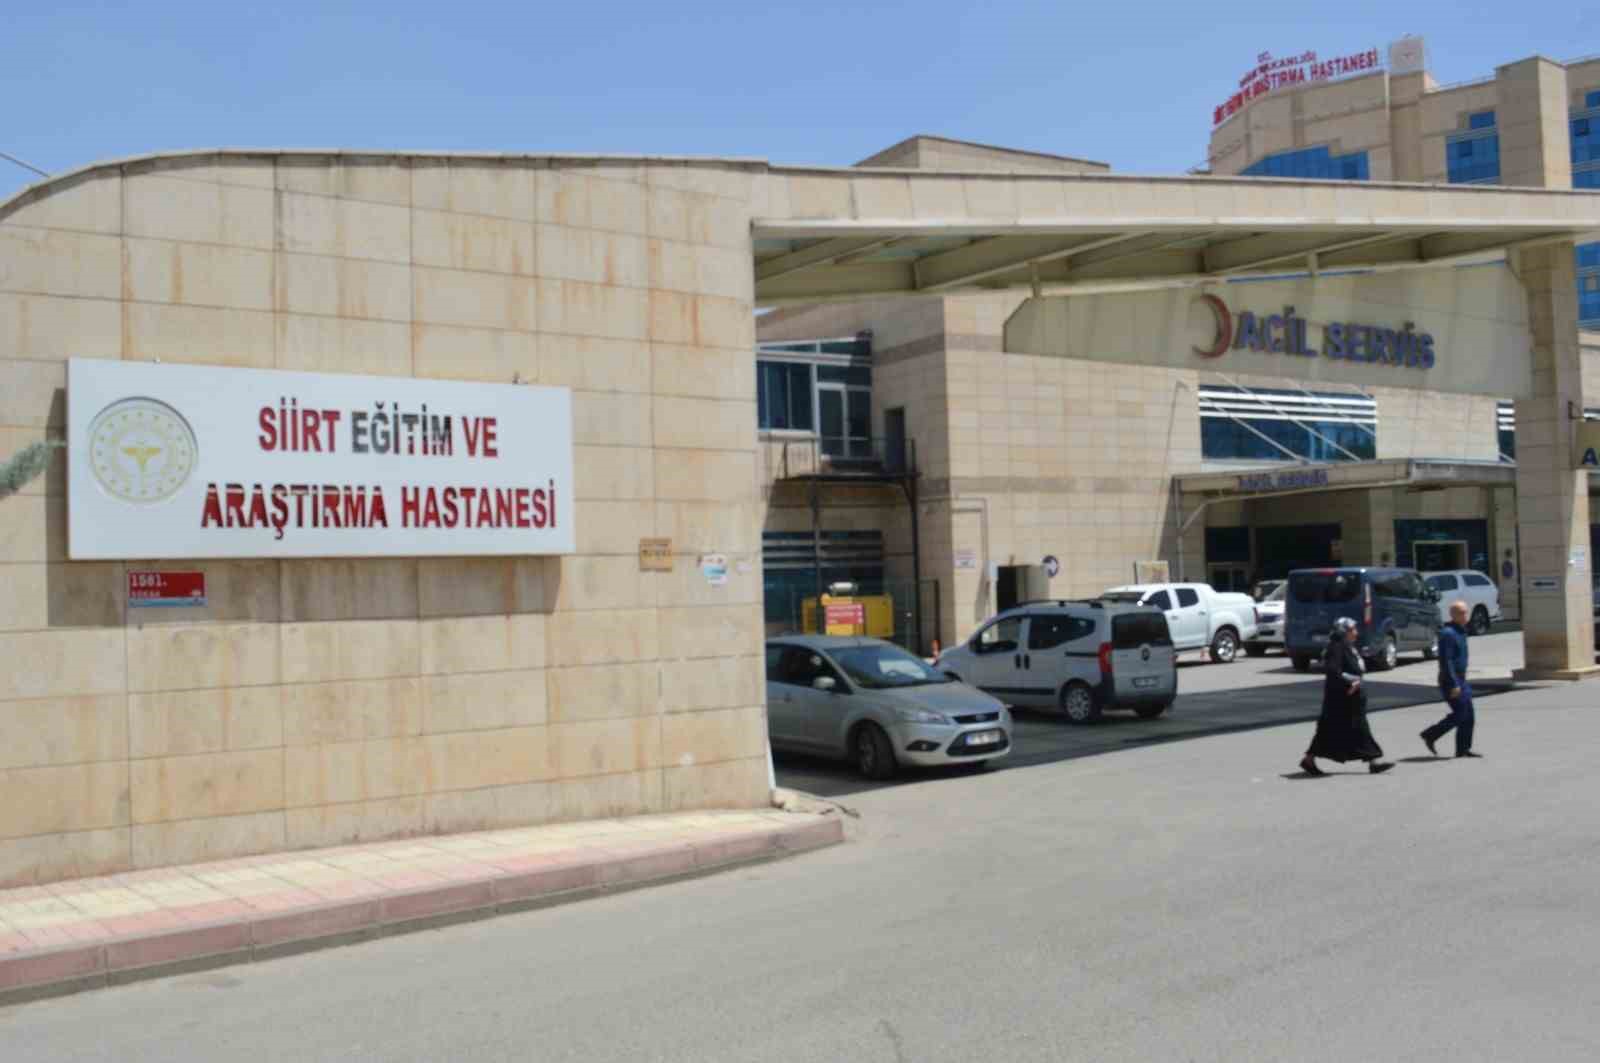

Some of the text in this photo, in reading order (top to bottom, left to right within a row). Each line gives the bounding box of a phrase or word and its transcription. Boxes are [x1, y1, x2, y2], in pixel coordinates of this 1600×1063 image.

[1310, 48, 1377, 80] HASTANESİ
[1233, 305, 1436, 370] ACİL SERVİS
[258, 397, 498, 458] SİİRT EĞİTİM VE
[201, 479, 556, 540] ARAŞTIRMA HASTANESİ
